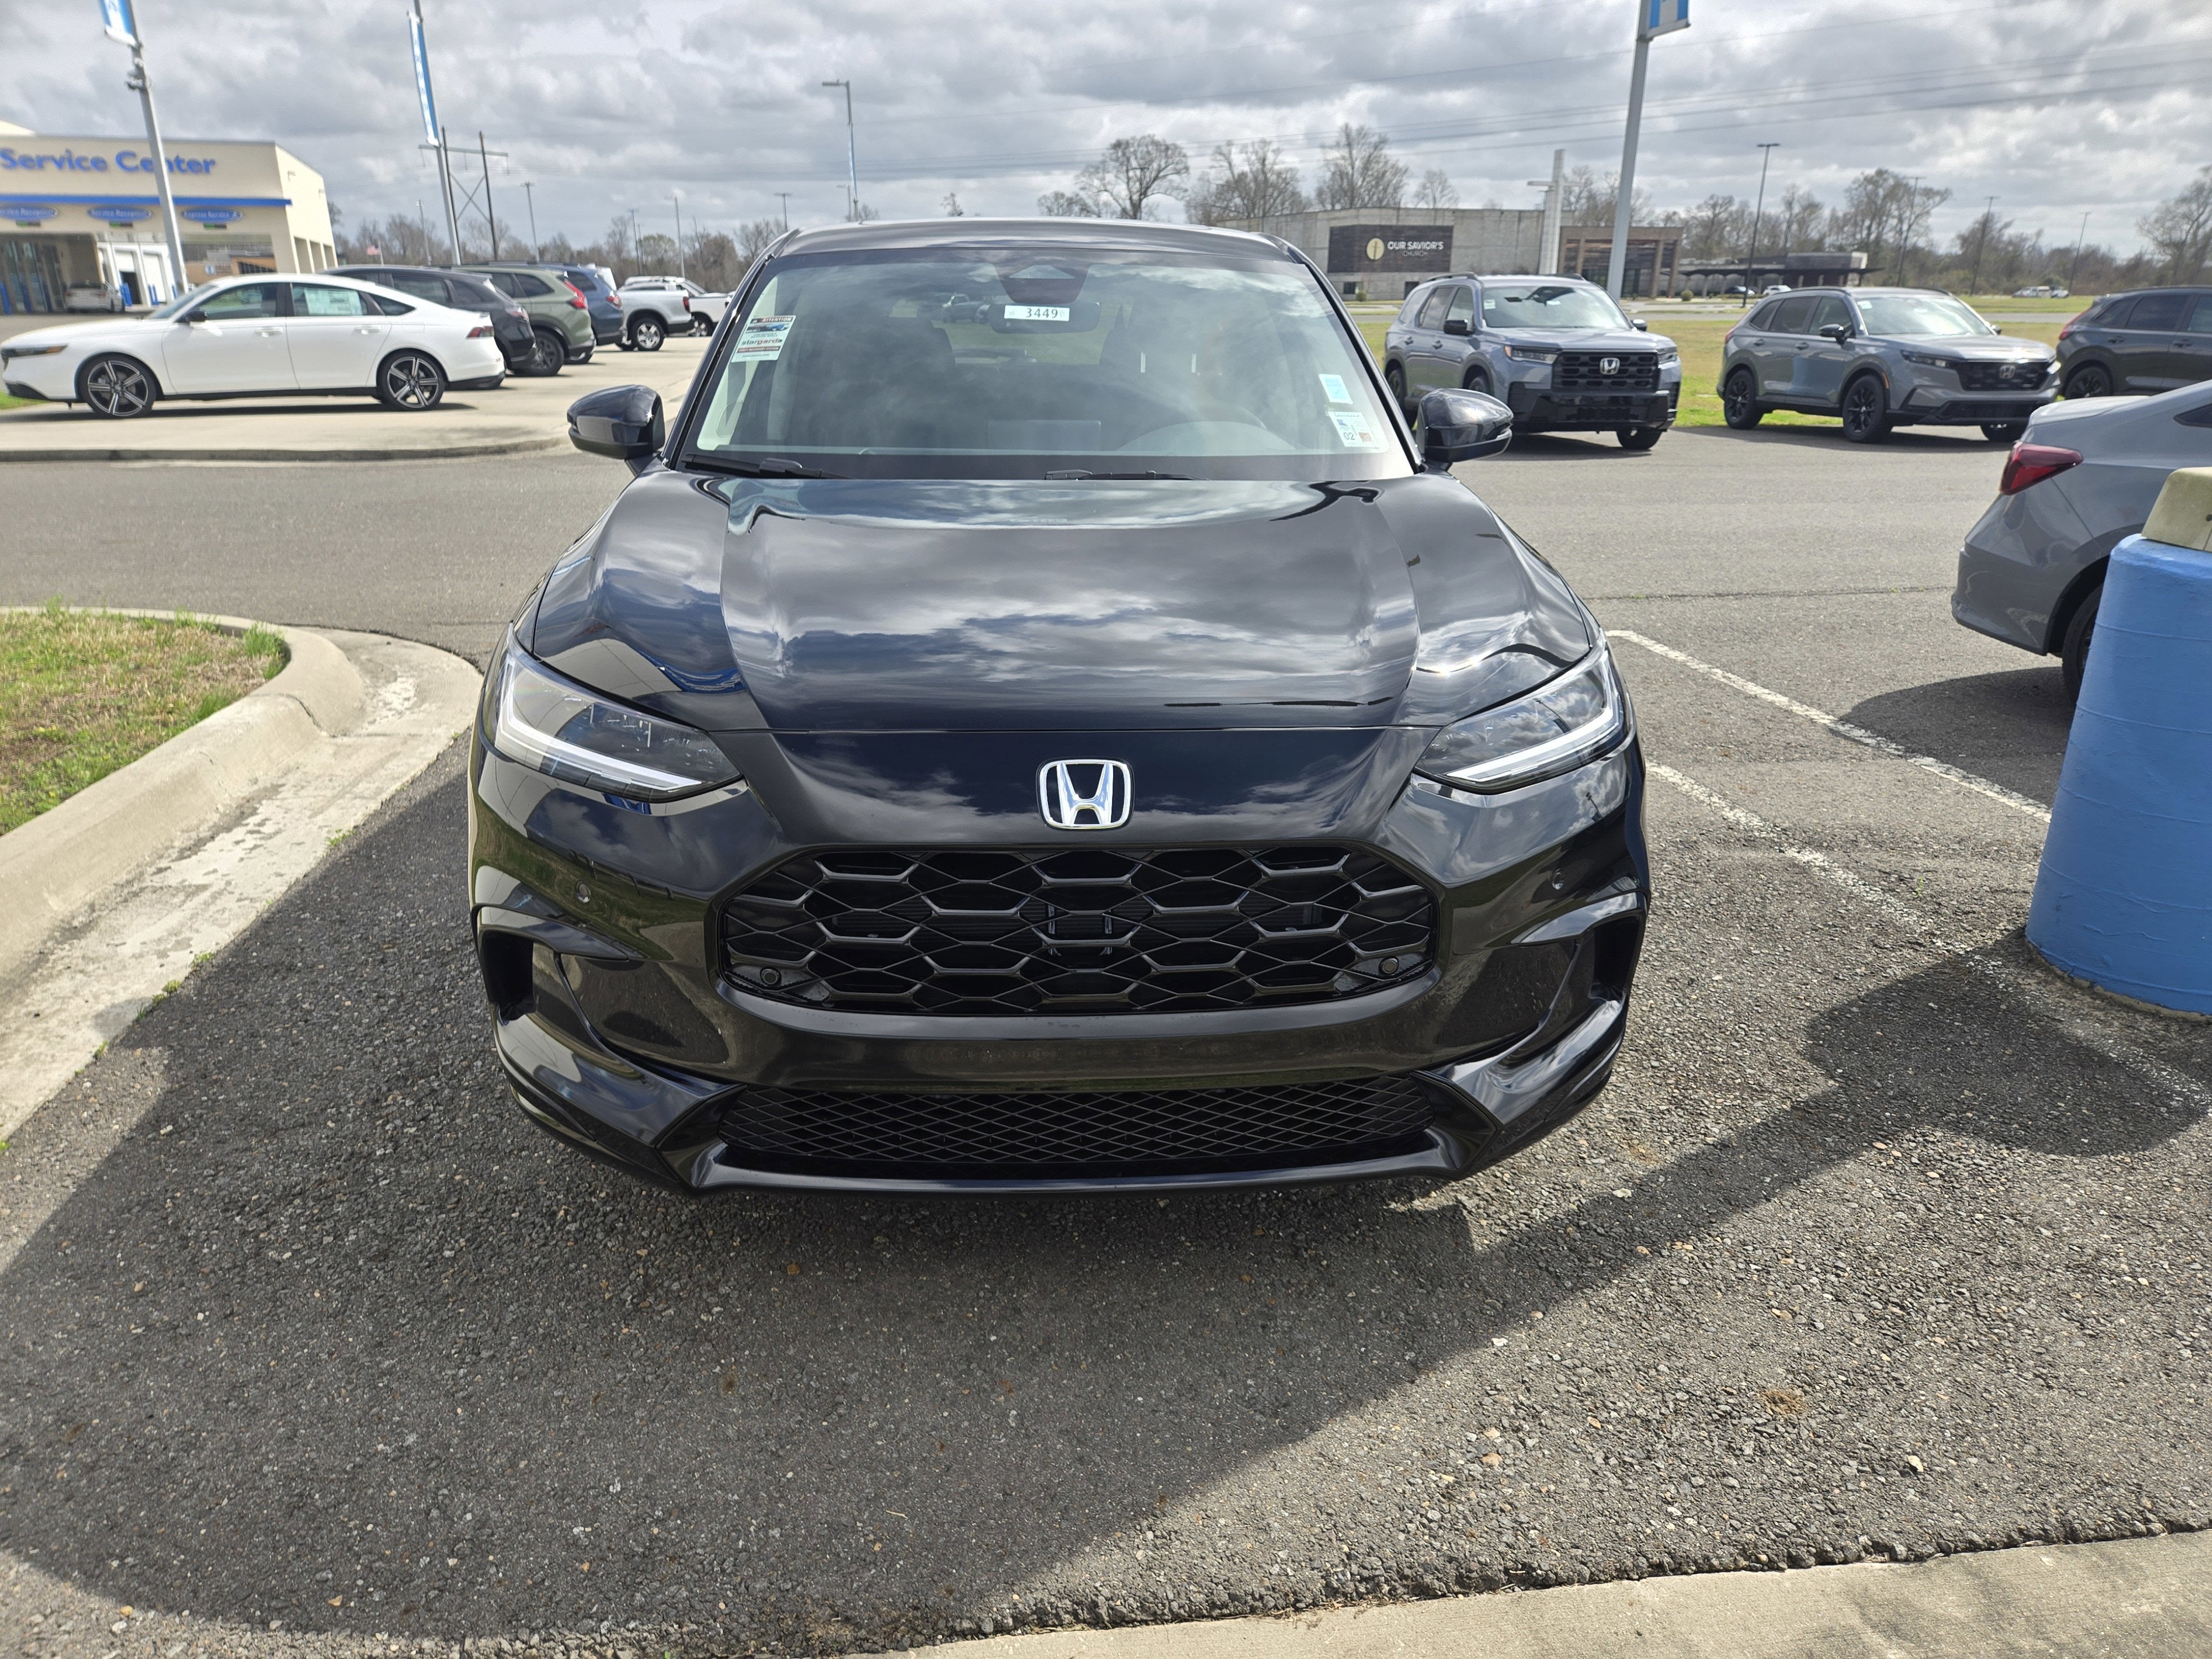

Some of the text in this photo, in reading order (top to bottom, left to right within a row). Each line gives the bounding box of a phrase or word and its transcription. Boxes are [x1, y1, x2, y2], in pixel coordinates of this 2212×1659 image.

[0, 148, 107, 171] Service
[1387, 241, 1406, 250] OUR
[1026, 308, 1058, 319] 3449
[1344, 432, 1356, 440] 02
